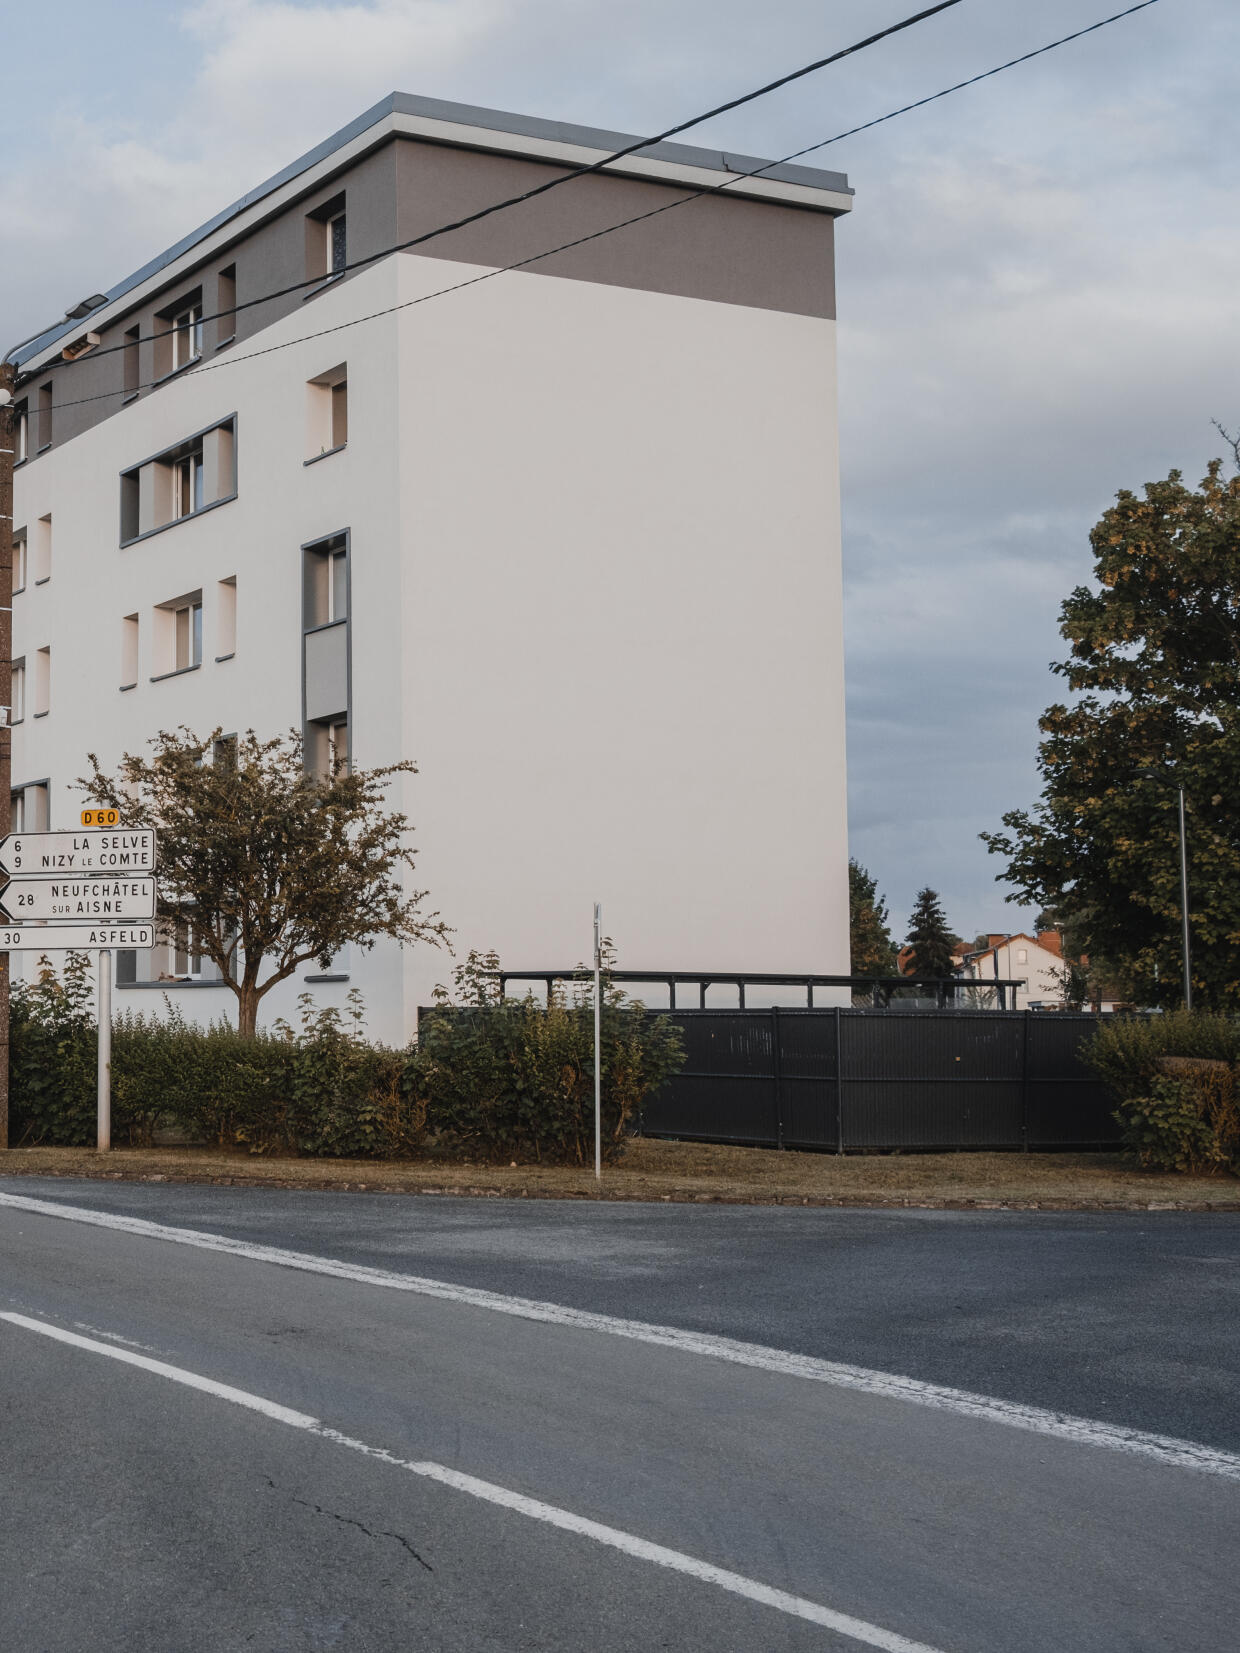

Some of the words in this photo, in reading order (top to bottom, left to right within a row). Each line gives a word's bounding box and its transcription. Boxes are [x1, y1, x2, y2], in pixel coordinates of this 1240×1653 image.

[85, 813, 92, 823] D
[98, 812, 115, 823] 60
[15, 841, 21, 852] 6
[74, 839, 89, 850] LA
[102, 836, 148, 849] SELVE
[15, 857, 21, 867] 9
[42, 855, 74, 867] NIZY
[82, 858, 92, 866] LE
[100, 853, 148, 865] COMTE
[52, 882, 148, 896] NEUFCHÂTEL
[18, 895, 33, 905] 28
[77, 901, 121, 912] AISNE
[5, 933, 20, 944] 30
[90, 931, 147, 942] ASFELD
